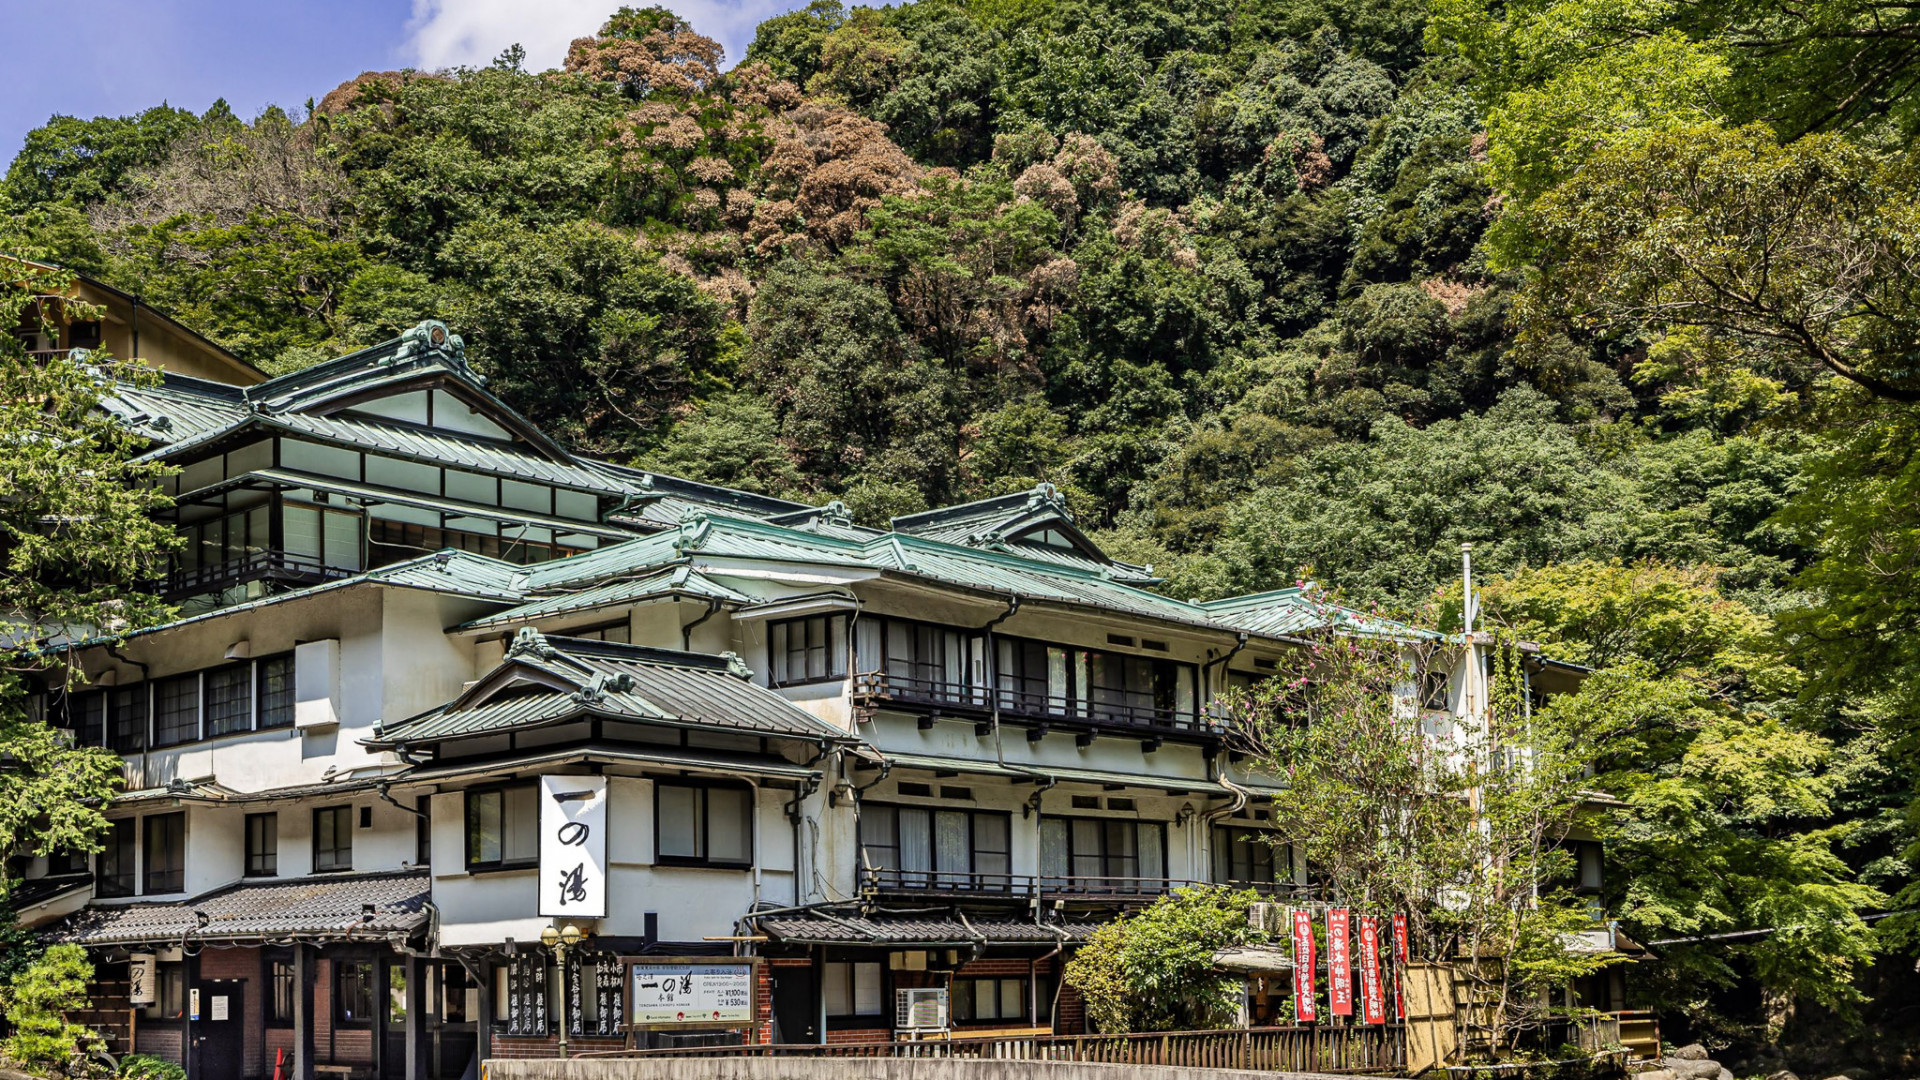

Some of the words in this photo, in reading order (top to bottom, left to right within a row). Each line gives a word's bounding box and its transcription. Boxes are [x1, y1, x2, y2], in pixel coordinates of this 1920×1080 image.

[552, 788, 596, 906] 一の湯
[130, 960, 146, 996] 一の湯
[641, 970, 692, 995] 一の湯
